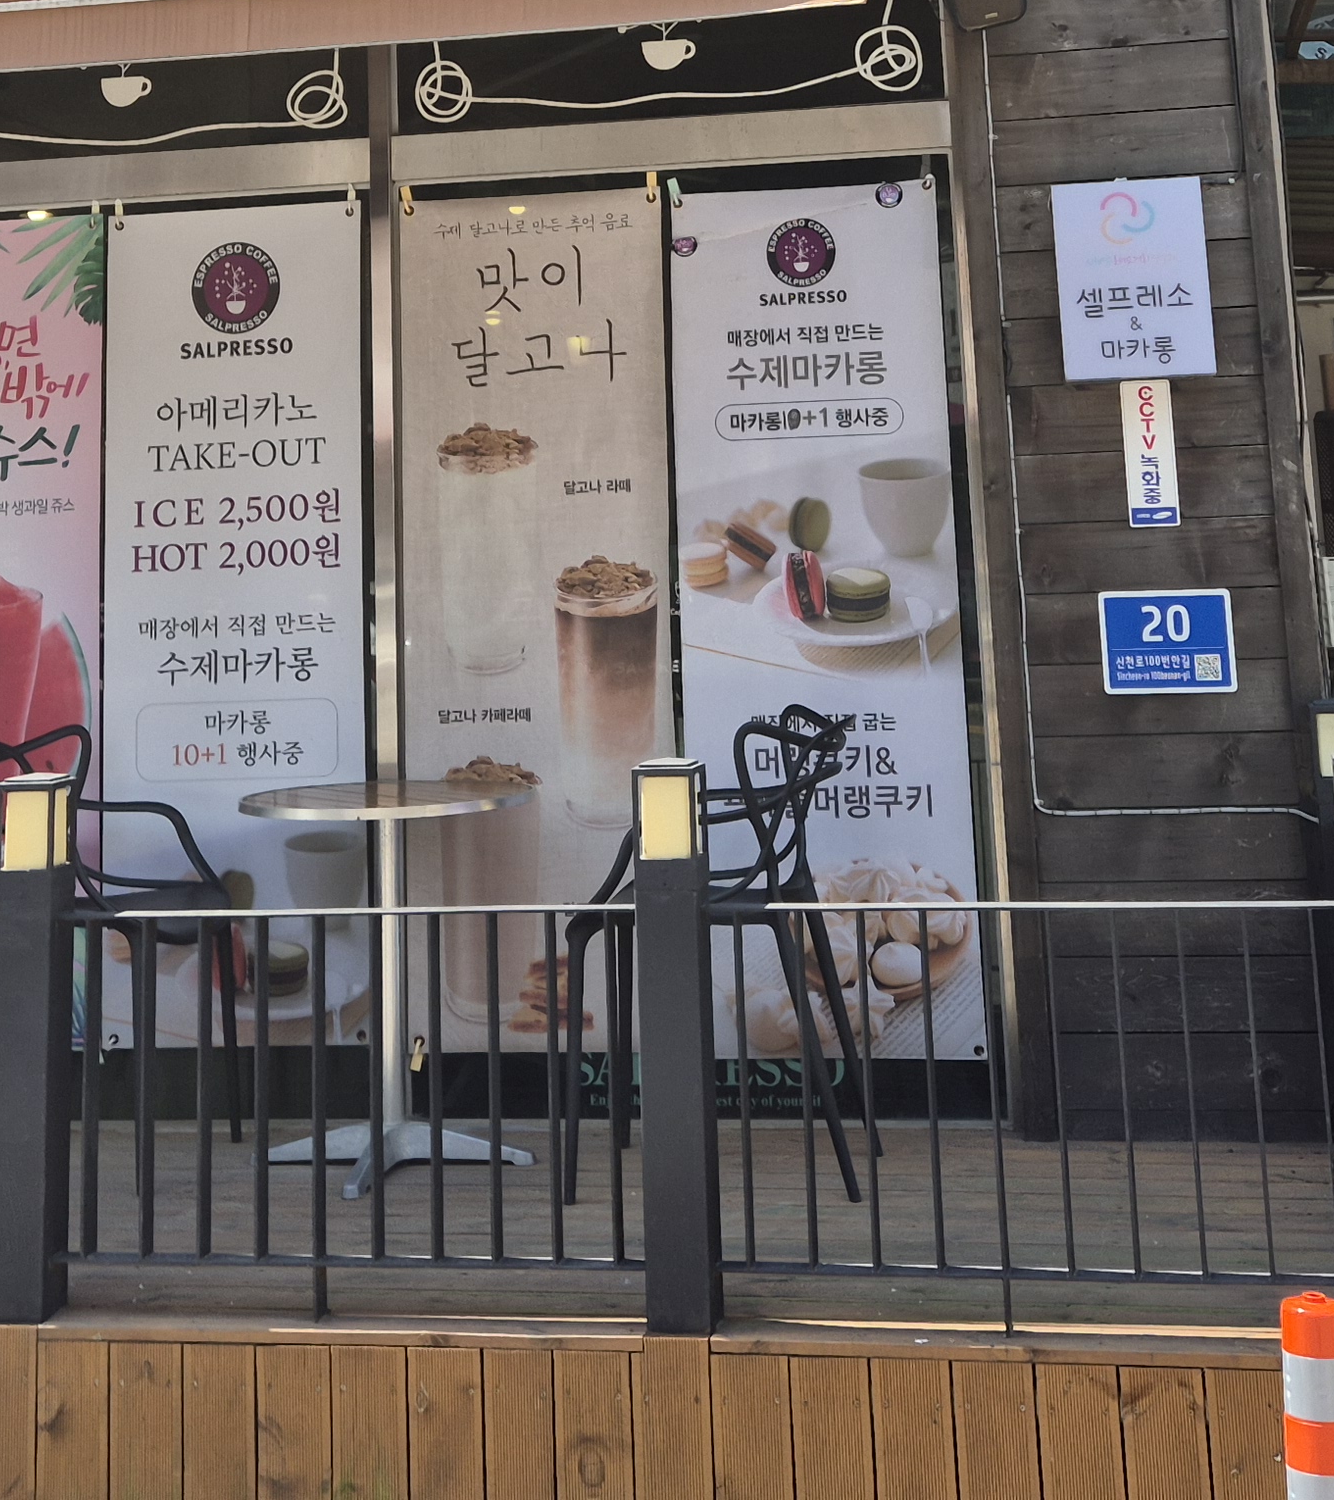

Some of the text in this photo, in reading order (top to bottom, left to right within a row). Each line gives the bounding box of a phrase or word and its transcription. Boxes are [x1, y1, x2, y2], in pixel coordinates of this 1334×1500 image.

[433, 212, 633, 239] 수제 달고나로 만든 추억 음료
[768, 219, 834, 252] ESPRESSO COFFEE
[194, 244, 278, 288] ESPRESSO COFFEE
[476, 244, 584, 313] 맛이
[777, 269, 827, 286] SALPRESSO
[759, 289, 847, 307] SALPRESSO
[1076, 283, 1194, 318] 셀프레소
[205, 310, 267, 332] SALPRESSO
[727, 323, 884, 347] 매장에서 직접 만드는
[1130, 316, 1143, 330] &
[180, 337, 293, 360] SALPRESSO
[451, 317, 627, 388] 달고나
[1101, 336, 1176, 364] 마카롱
[726, 350, 887, 391] 수제마카롱
[157, 392, 317, 432] 아메리카노
[835, 407, 889, 428] 행사중
[1138, 386, 1156, 449] CCTV
[147, 437, 326, 472] TAKE-OUT
[563, 478, 631, 495] 달고나 라떼
[1140, 453, 1162, 504] 녹화중
[12, 498, 48, 516] 생과일
[51, 497, 75, 514] 쥬스
[134, 487, 341, 531] ICE 2,500원
[131, 532, 341, 576] HOT 2,000원
[138, 612, 336, 641] 매장에서 직접 만드는
[1141, 604, 1190, 642] 20
[157, 646, 319, 687] 수제마카롱
[204, 710, 271, 736] 마카롱
[438, 707, 531, 724] 달고나 카페라떼
[862, 712, 897, 731] 굽는
[173, 740, 304, 767] 10+1 행사중
